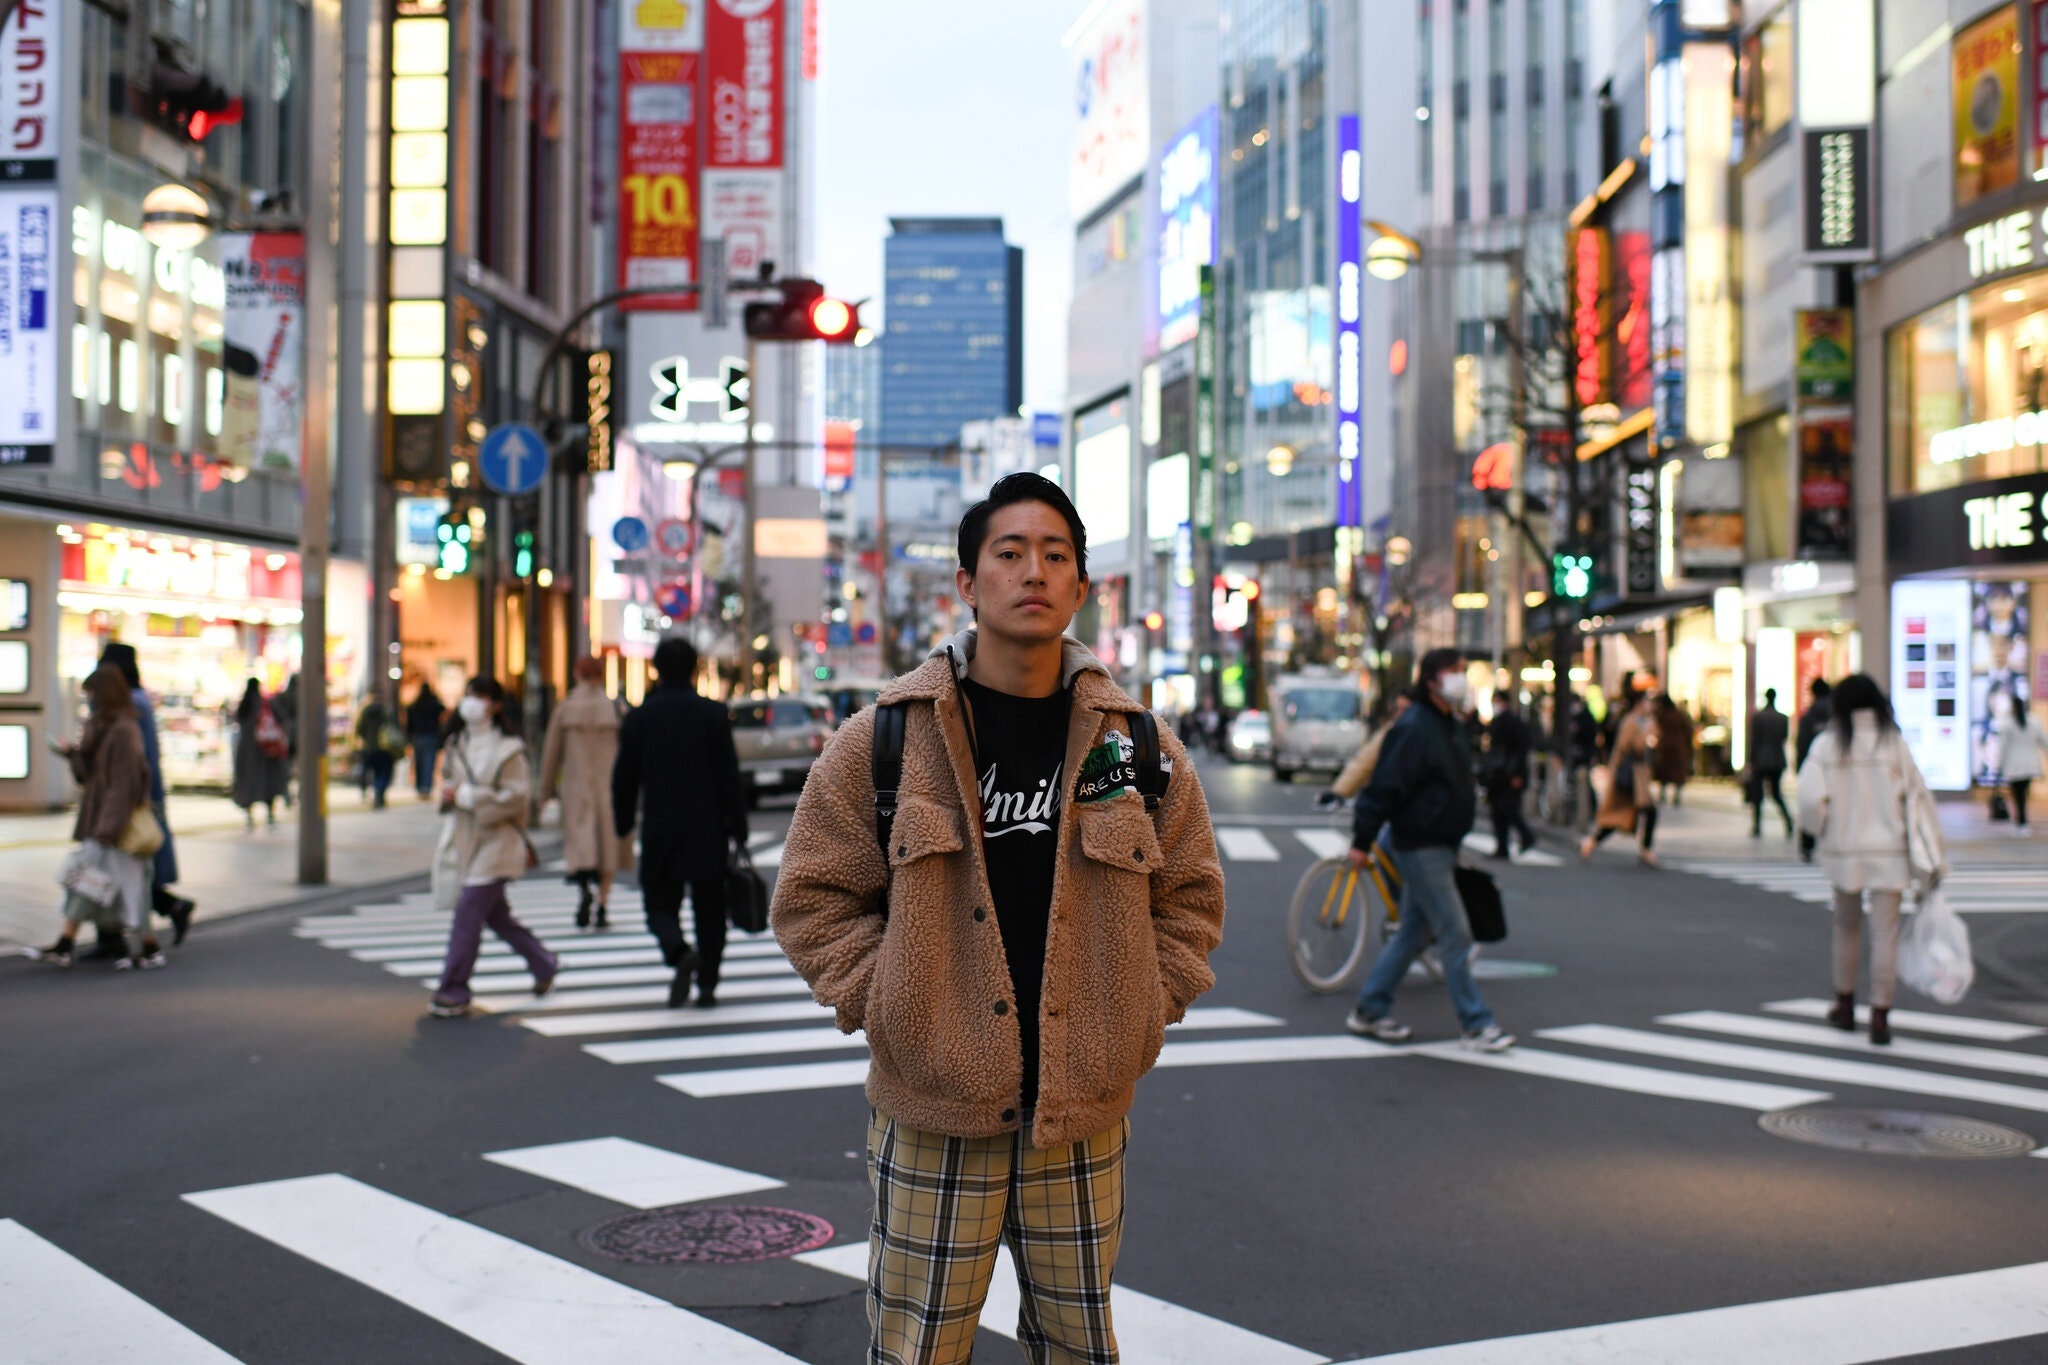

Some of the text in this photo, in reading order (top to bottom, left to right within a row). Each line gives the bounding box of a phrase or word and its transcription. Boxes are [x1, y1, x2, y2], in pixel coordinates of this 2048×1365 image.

[1964, 210, 2033, 279] THE
[1963, 491, 2034, 550] THE
[1079, 776, 1109, 797] ARE
[1109, 767, 1122, 782] U
